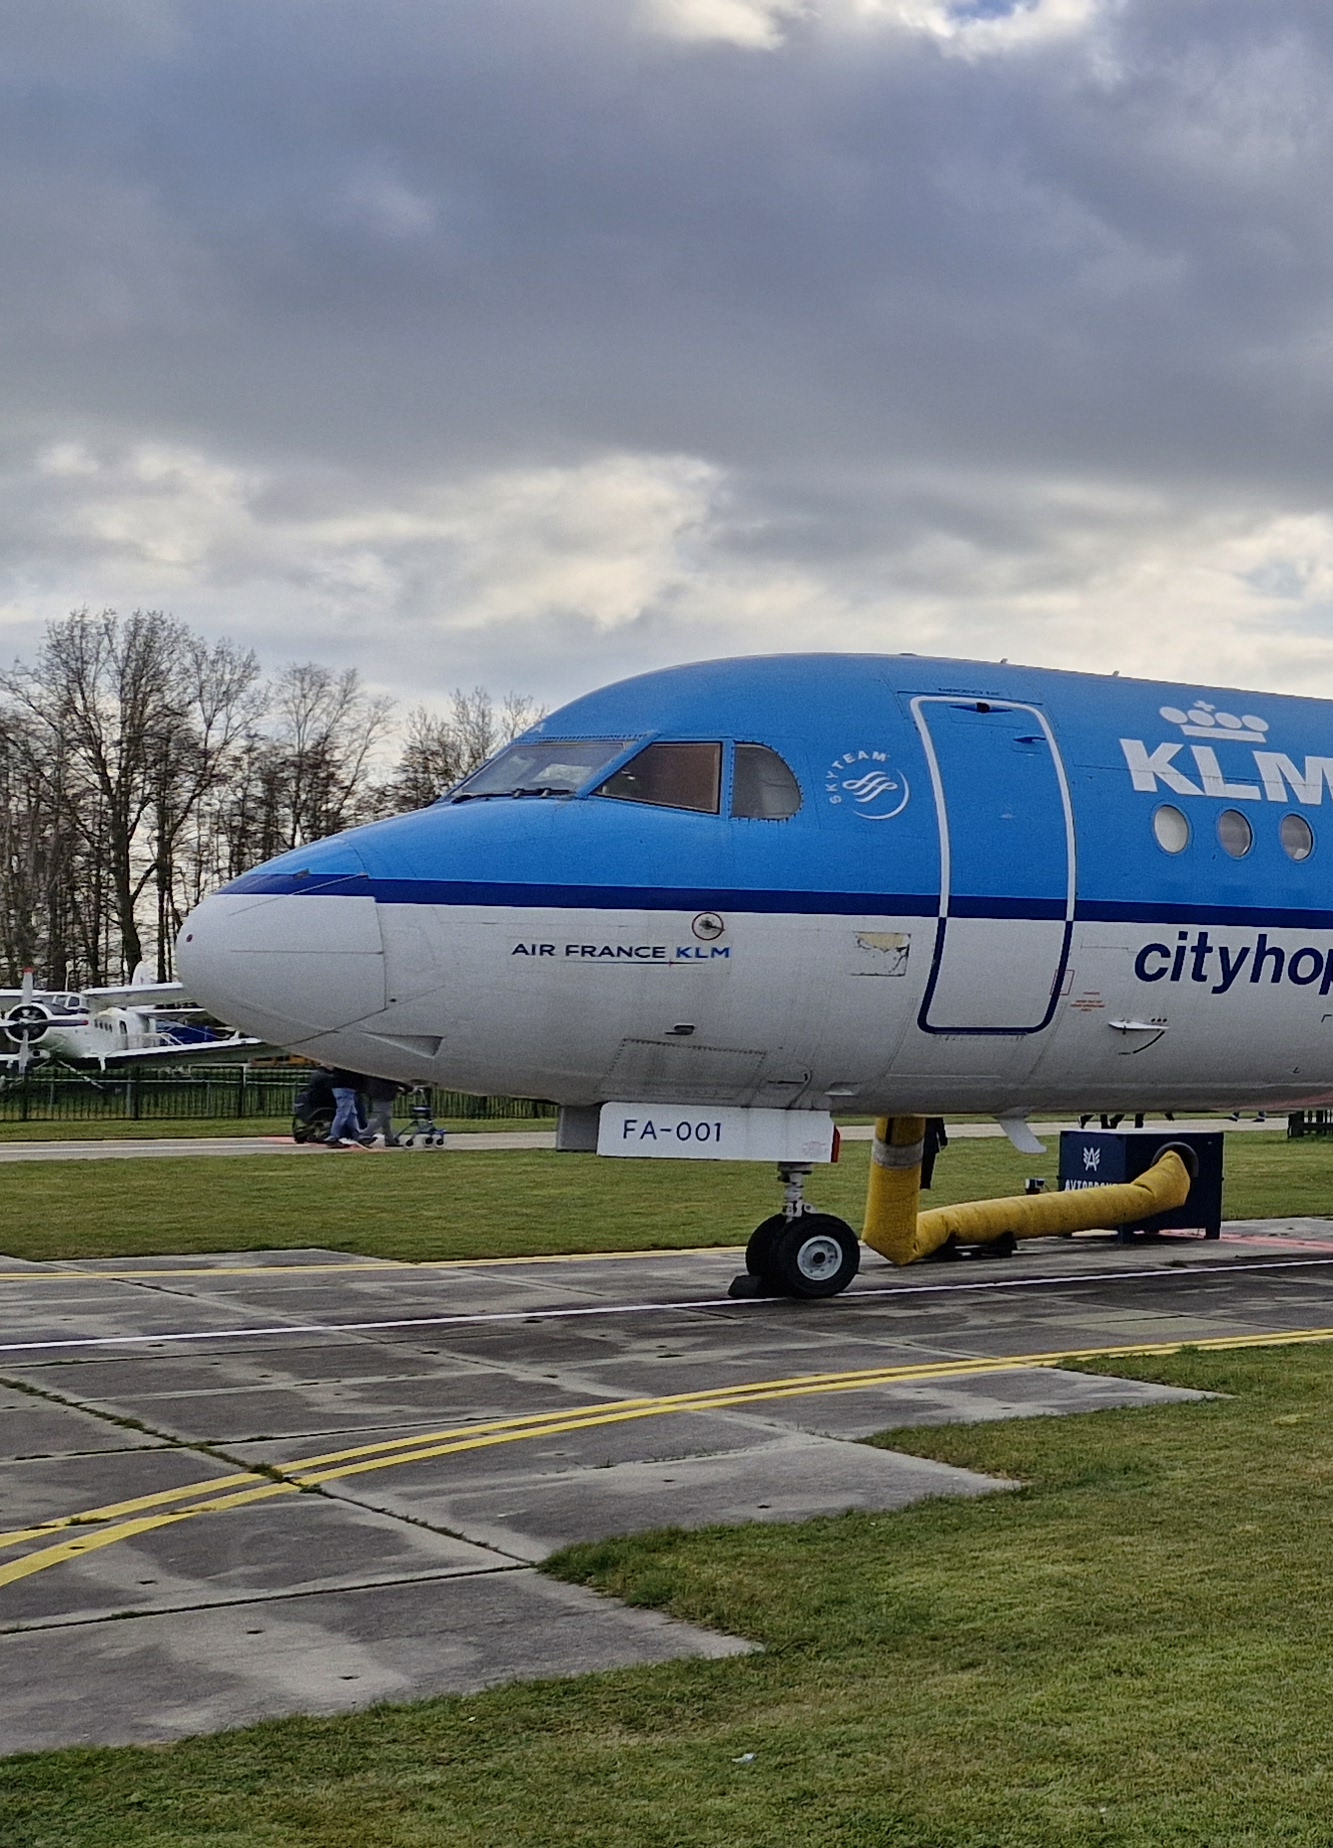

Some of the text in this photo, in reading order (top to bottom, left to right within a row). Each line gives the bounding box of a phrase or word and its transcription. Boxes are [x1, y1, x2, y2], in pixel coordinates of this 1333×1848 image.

[824, 750, 886, 804] SKYTEAM
[511, 943, 730, 958] AIR FRANCE KLM
[623, 1119, 722, 1142] FA-001
